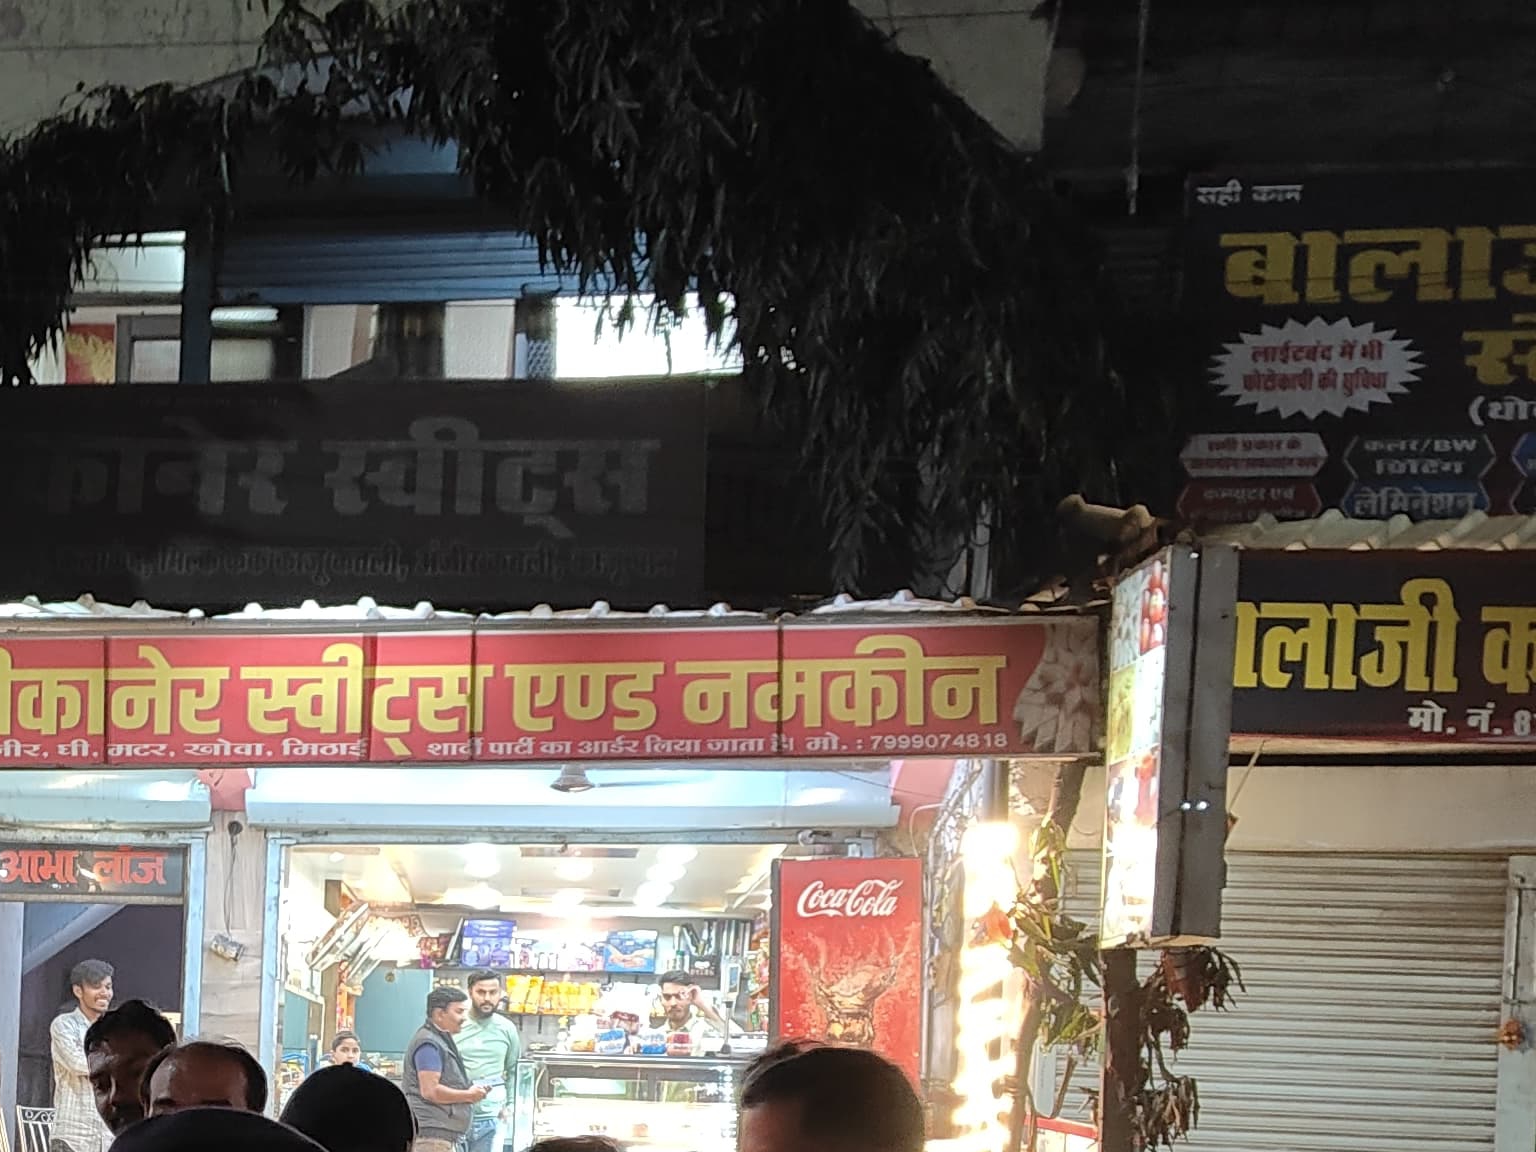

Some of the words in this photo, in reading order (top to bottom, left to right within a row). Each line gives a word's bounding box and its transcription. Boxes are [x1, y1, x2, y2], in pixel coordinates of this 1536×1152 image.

[1233, 577, 1461, 693] ालाजी
[239, 642, 495, 756] स्वीट्स
[504, 661, 665, 732] एण्ड
[675, 635, 1006, 729] नमकीन
[540, 741, 572, 755] का
[645, 734, 701, 753] लिया
[707, 738, 764, 752] जाता
[870, 733, 1007, 750] 7999074818
[0, 849, 79, 884] आभा
[93, 844, 168, 885] लॉज
[797, 879, 904, 918] Coca-Cola
